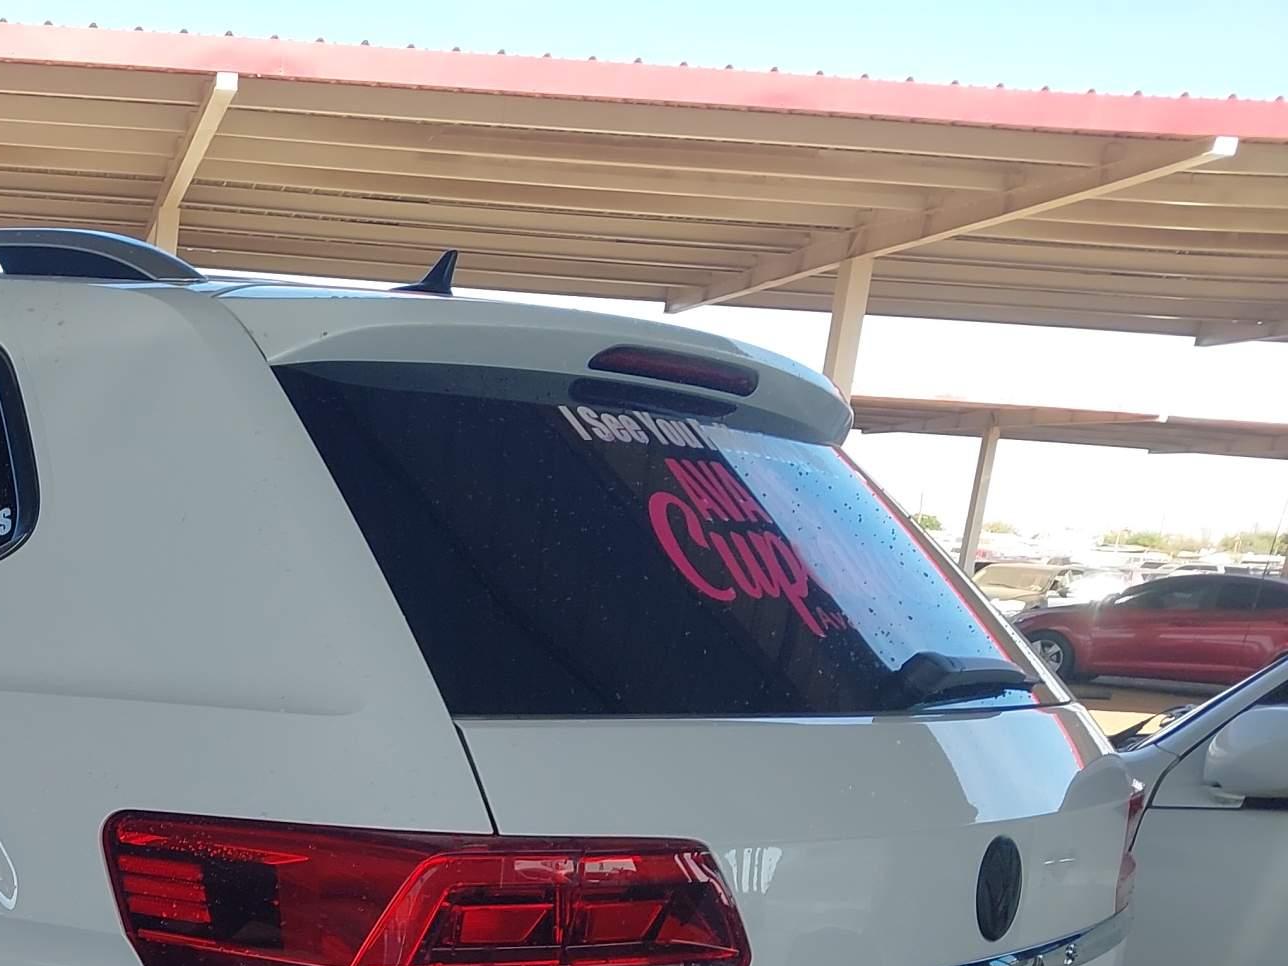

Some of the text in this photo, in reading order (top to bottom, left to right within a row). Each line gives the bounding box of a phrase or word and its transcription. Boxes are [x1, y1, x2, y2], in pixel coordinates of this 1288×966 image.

[558, 405, 593, 441] I
[576, 405, 650, 444] See
[632, 410, 704, 449] You
